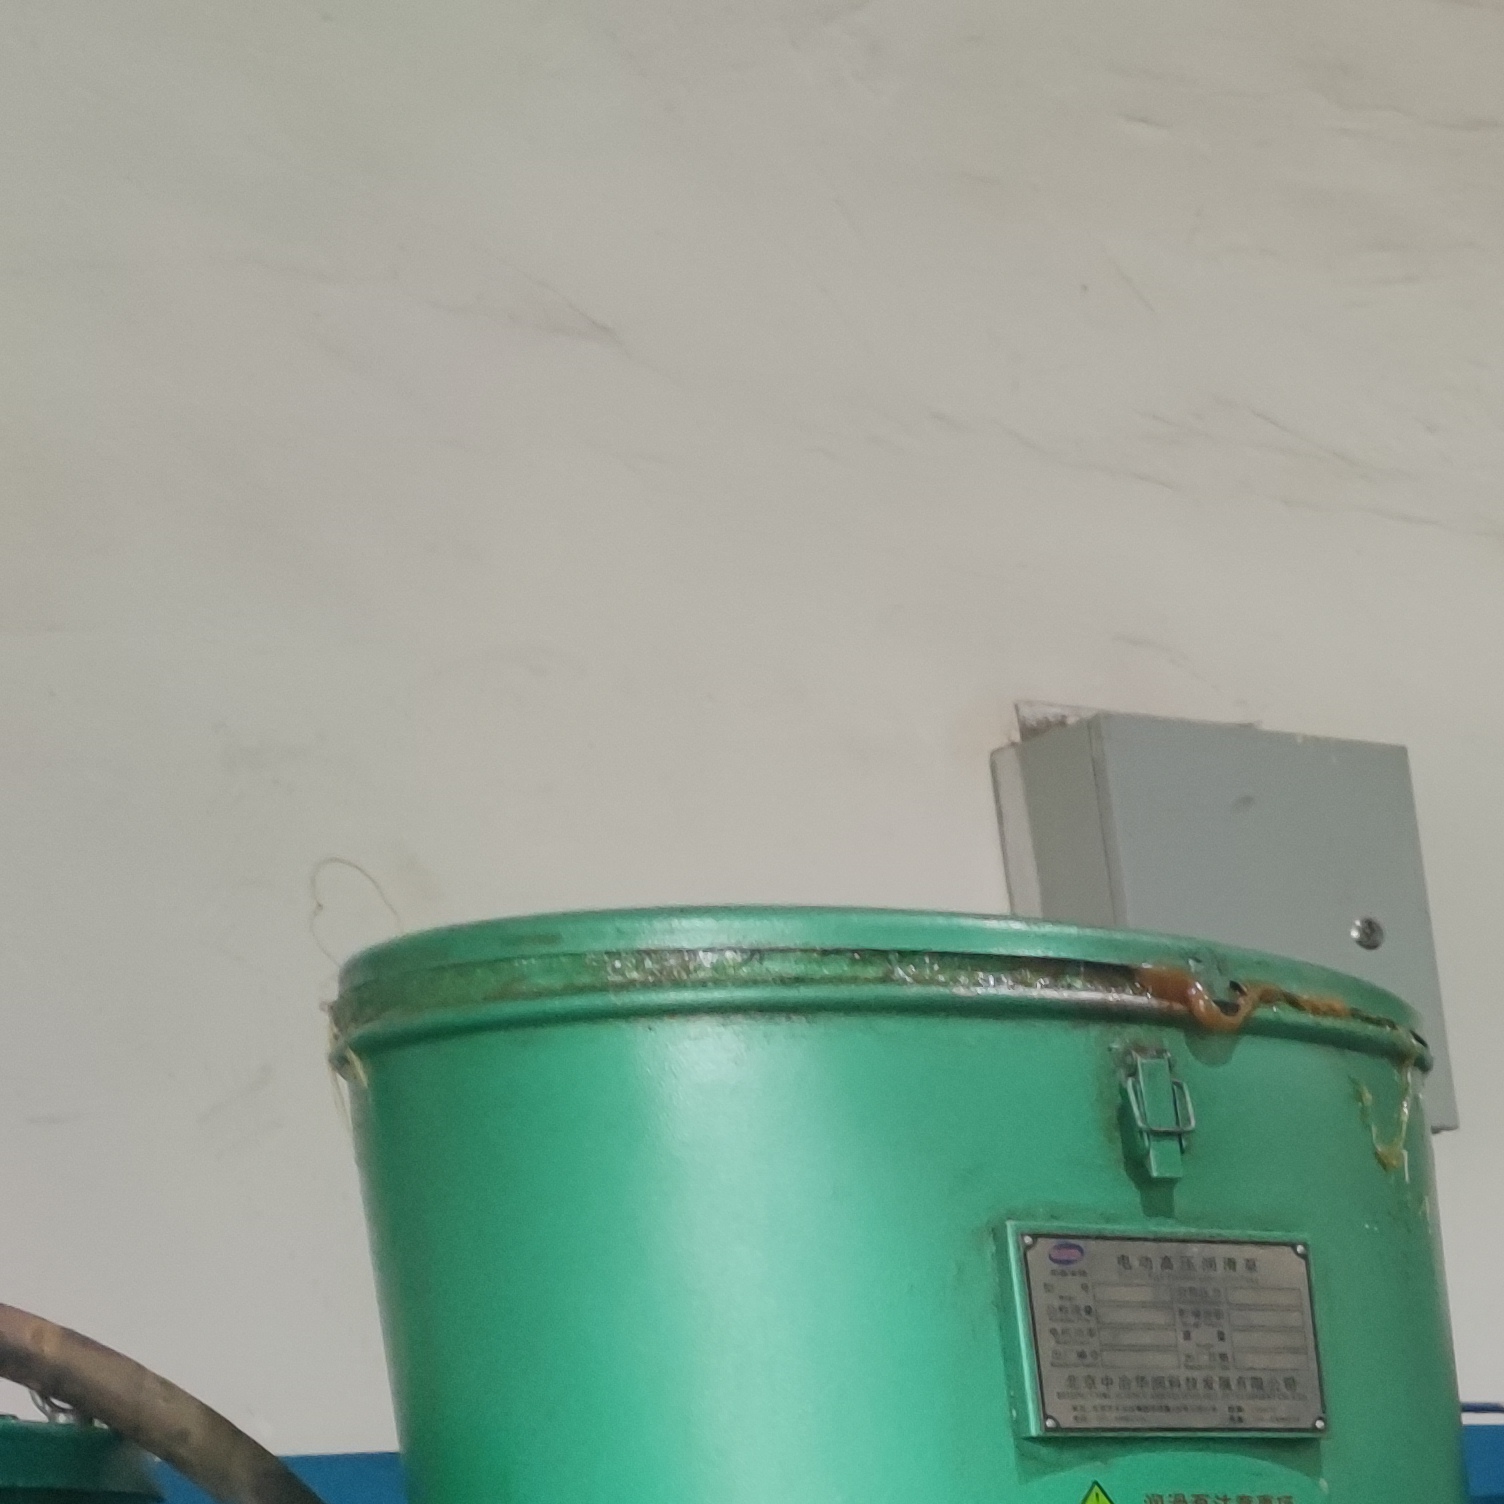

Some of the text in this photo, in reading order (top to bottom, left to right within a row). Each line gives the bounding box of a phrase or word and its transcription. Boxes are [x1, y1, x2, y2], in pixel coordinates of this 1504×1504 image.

[1117, 1253, 1259, 1273] 电动高压润滑泵
